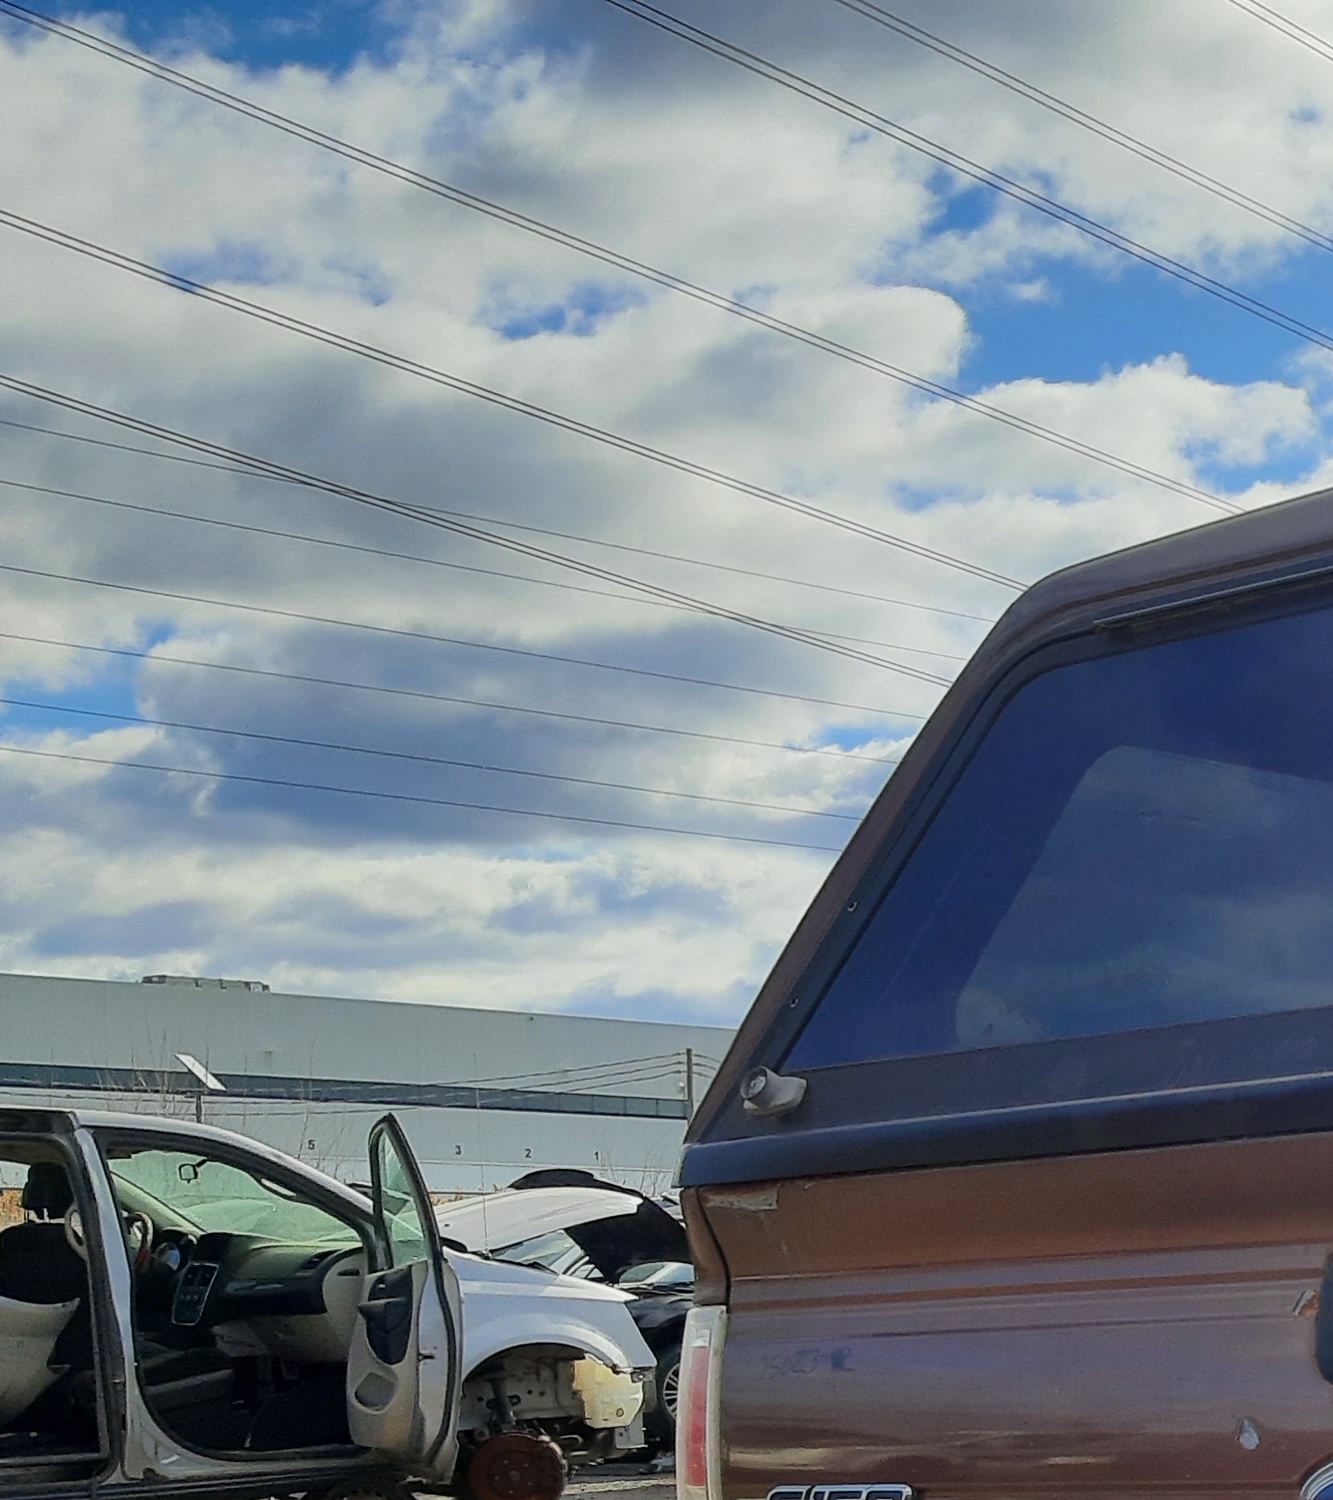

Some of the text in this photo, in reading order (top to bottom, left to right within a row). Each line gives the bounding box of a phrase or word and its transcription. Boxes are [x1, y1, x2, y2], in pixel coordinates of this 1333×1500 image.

[307, 1138, 316, 1151] 5
[455, 1145, 463, 1156] 3
[524, 1148, 532, 1159] 2
